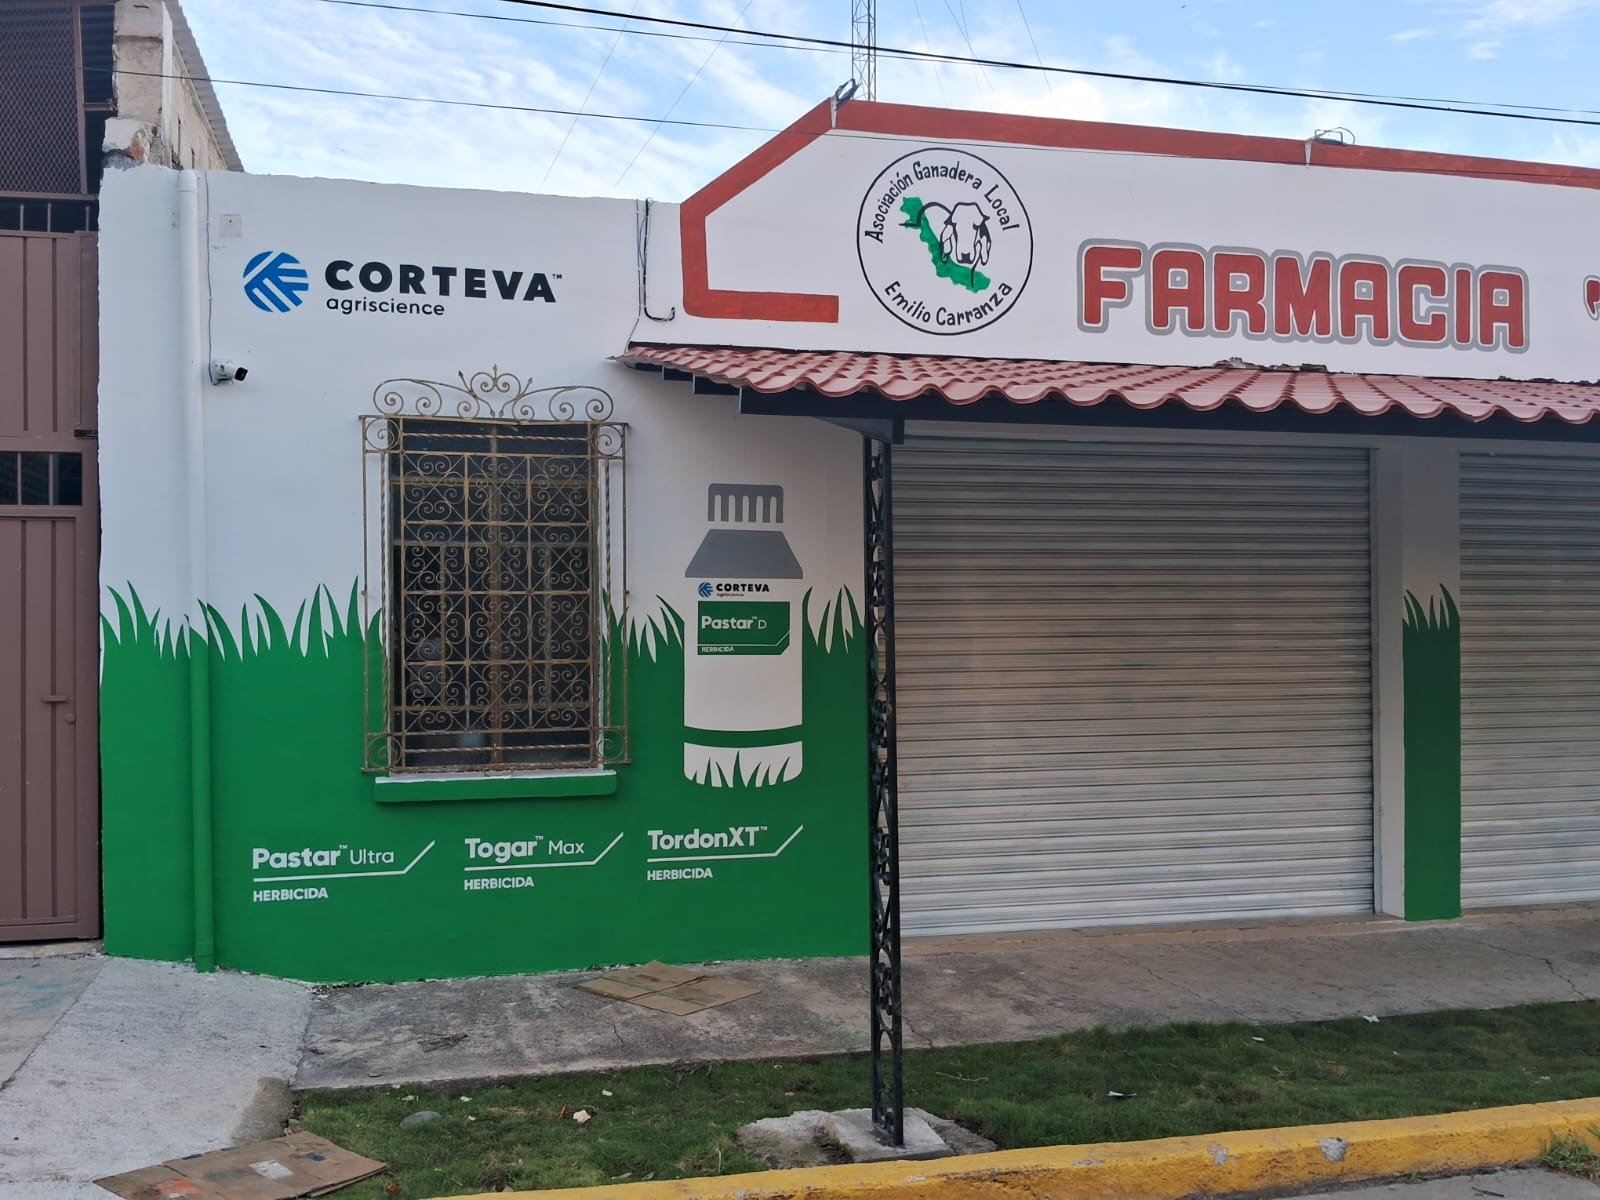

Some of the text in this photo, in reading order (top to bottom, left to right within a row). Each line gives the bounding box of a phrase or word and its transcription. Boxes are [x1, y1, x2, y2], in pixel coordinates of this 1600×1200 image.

[864, 160, 1020, 244] Asociación Ganadera Local
[884, 280, 1013, 326] Emilio Carranza
[1078, 238, 1530, 354] FARMACIA
[326, 297, 445, 315] agriscience
[716, 583, 770, 593] CORTEVA
[757, 619, 767, 630] D
[548, 840, 584, 855] Max
[349, 849, 395, 865] Ultra
[647, 867, 713, 881] HERBICIDA
[464, 876, 534, 890] HERBICIDA
[253, 887, 329, 902] HERBICIDA
